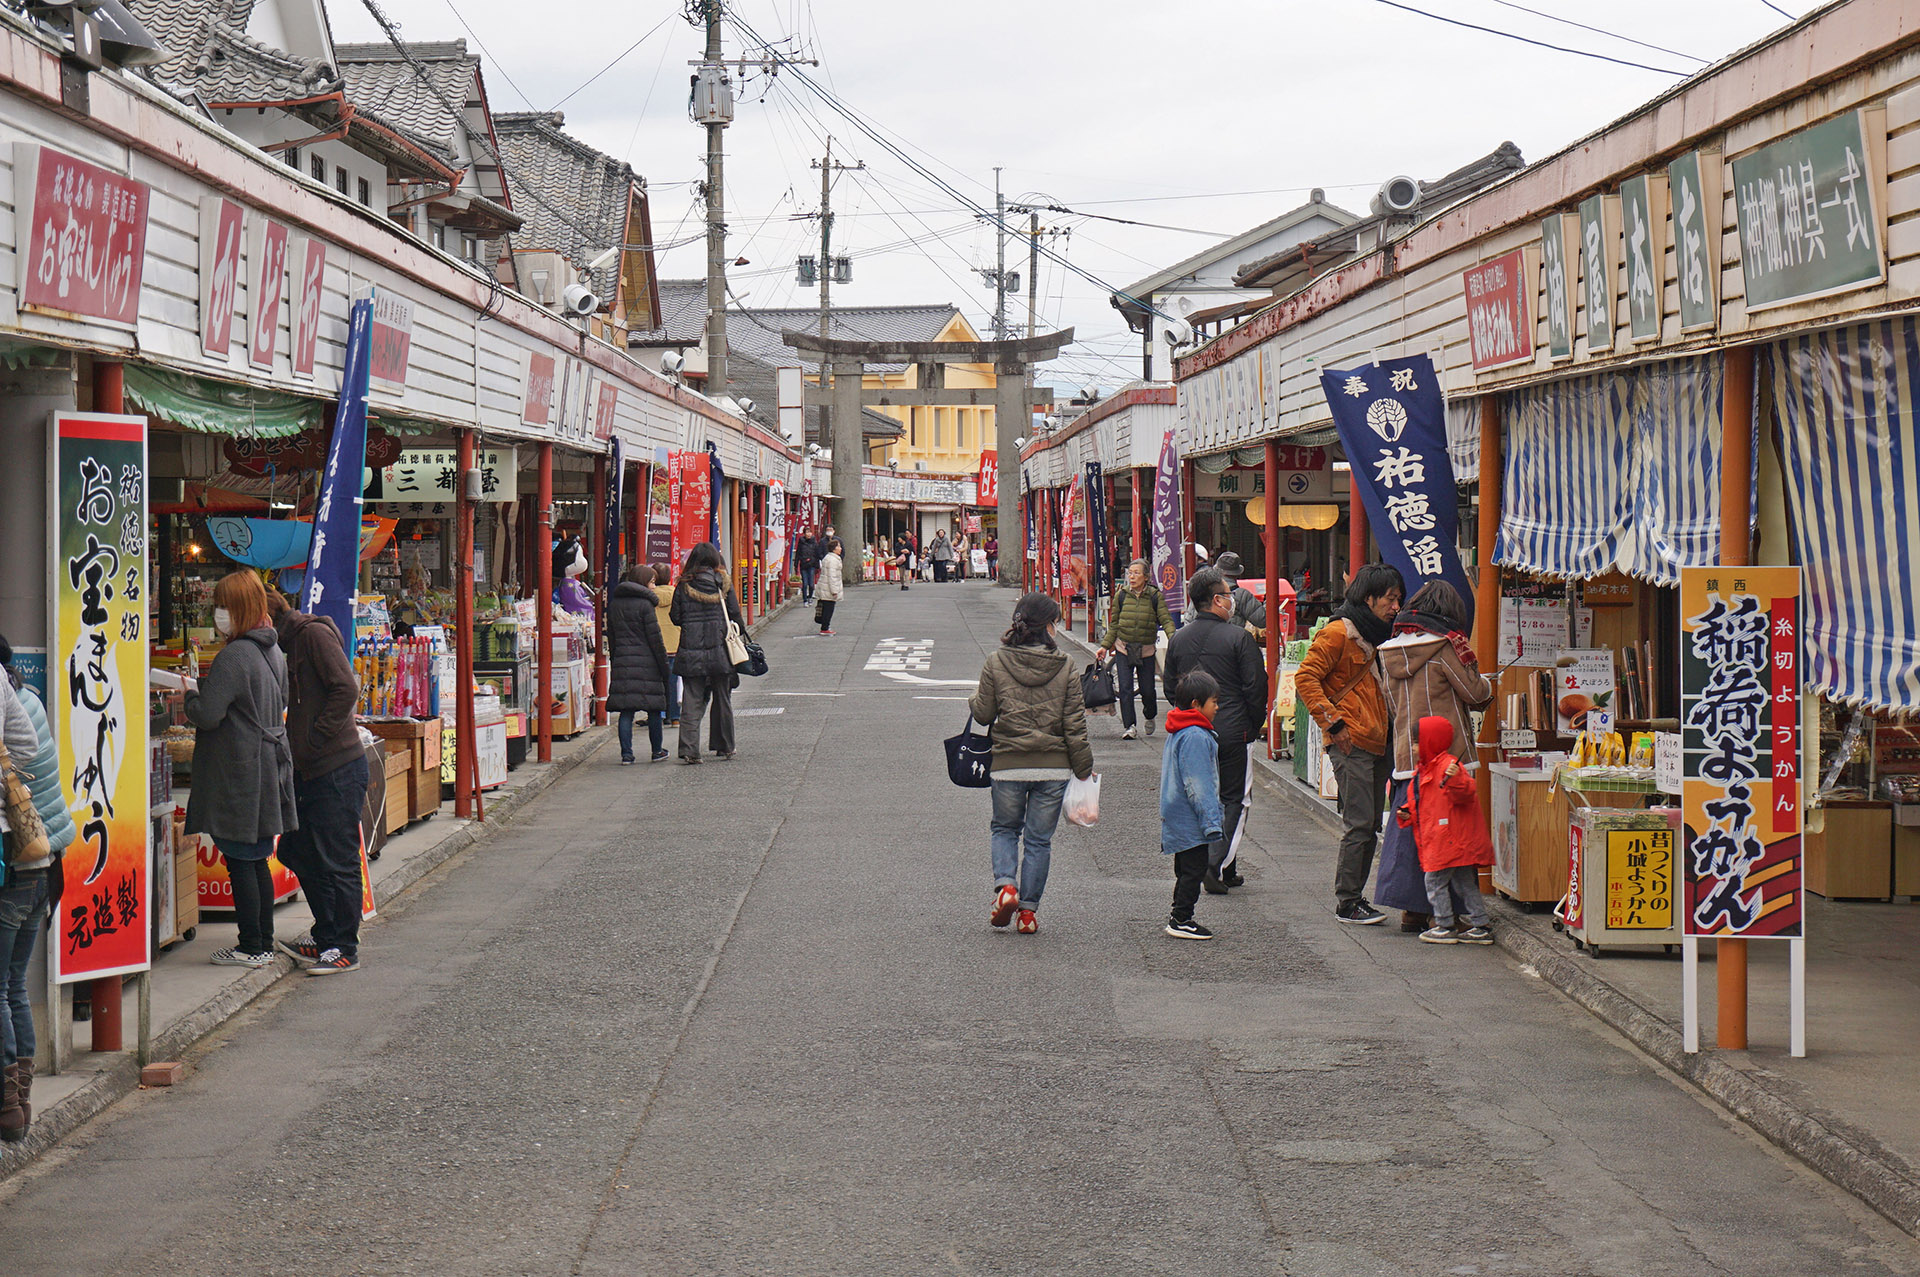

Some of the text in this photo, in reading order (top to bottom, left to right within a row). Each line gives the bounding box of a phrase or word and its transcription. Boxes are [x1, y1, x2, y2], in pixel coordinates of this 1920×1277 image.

[38, 206, 134, 317] お宝まんじゅう
[101, 181, 137, 224] 製造販売
[1742, 146, 1870, 279] 神棚神具一式
[119, 463, 144, 642] 祐徳名物
[68, 456, 120, 887] お宝まんじゅう
[1565, 674, 1581, 689] 生
[1773, 617, 1795, 814] 糸切ようかん
[1687, 592, 1771, 931] 稲荷ようかん
[1627, 838, 1648, 925] 小城ようかん
[1650, 832, 1670, 911] 昔つくりの
